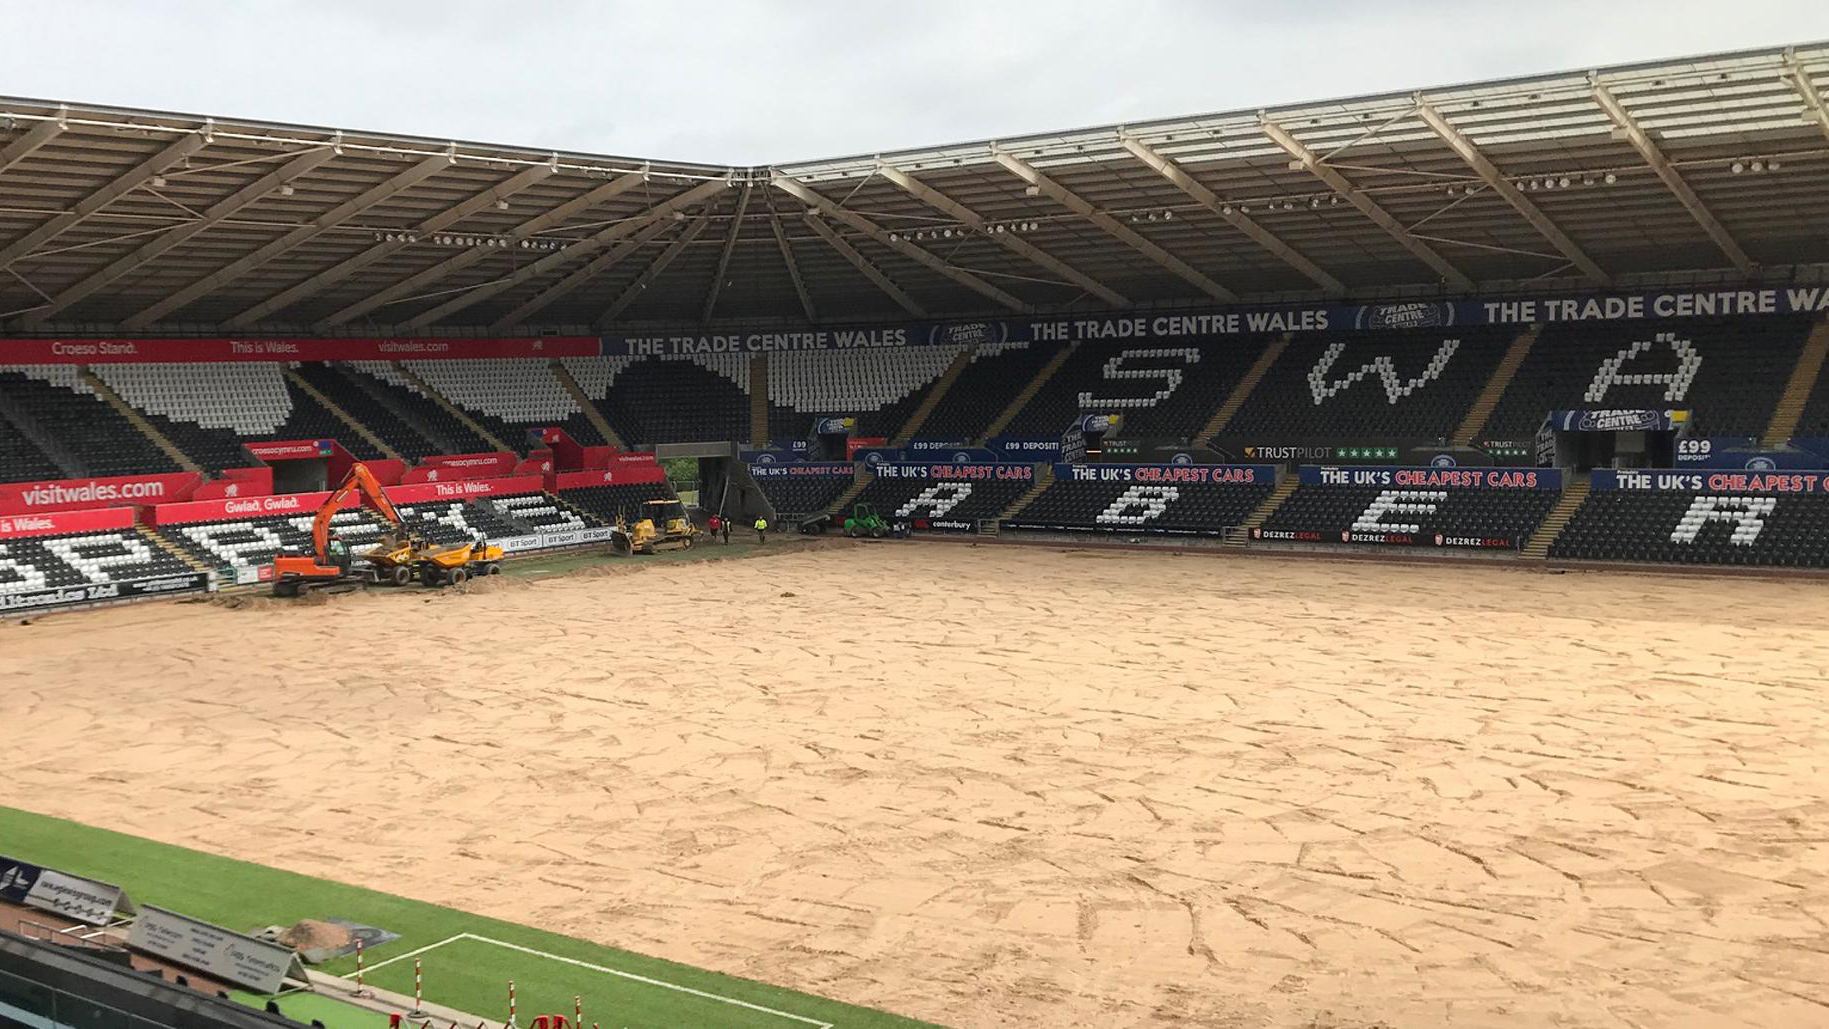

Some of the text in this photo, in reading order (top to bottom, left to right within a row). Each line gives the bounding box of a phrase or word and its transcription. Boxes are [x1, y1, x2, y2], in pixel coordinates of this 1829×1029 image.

[1484, 302, 1535, 323] THE
[1545, 296, 1644, 321] TRADE
[1653, 289, 1776, 317] CENTRE
[1031, 310, 1329, 341] THE TRADE CENTRE WALES
[52, 342, 97, 354] Croeso
[230, 341, 254, 353] This
[265, 341, 299, 353] Wales.
[378, 340, 449, 352] visitwales.com
[625, 329, 906, 355] THE TRADE CENTRE WALES
[1596, 414, 1642, 428] CENTRE
[1005, 442, 1059, 450] £99 DEPOSIT!
[1257, 447, 1332, 458] TRUSTPILOT
[1678, 440, 1711, 453] £99
[751, 467, 767, 476] THE
[768, 467, 788, 476] UK'S
[876, 465, 1032, 479] THE UK'S CHEAPEST CARS
[1072, 467, 1255, 482] THE UK'S CHEAPEST CARS
[1320, 470, 1538, 487] THE UK'S CHEAPEST CARS
[1616, 474, 1652, 489] THE
[1658, 474, 1703, 489] UK'S
[1708, 474, 1818, 492] CHEAPEST
[22, 482, 164, 506] visitwales.com
[436, 484, 454, 496] This
[455, 484, 462, 495] is
[225, 498, 300, 514] Gwlad, Gwlad.
[1, 518, 55, 532] is Wales.
[933, 520, 971, 530] canterbury
[548, 533, 575, 543] BT Sport
[583, 530, 608, 539] BT Sport
[510, 540, 520, 548] BT
[520, 538, 537, 548] Sport
